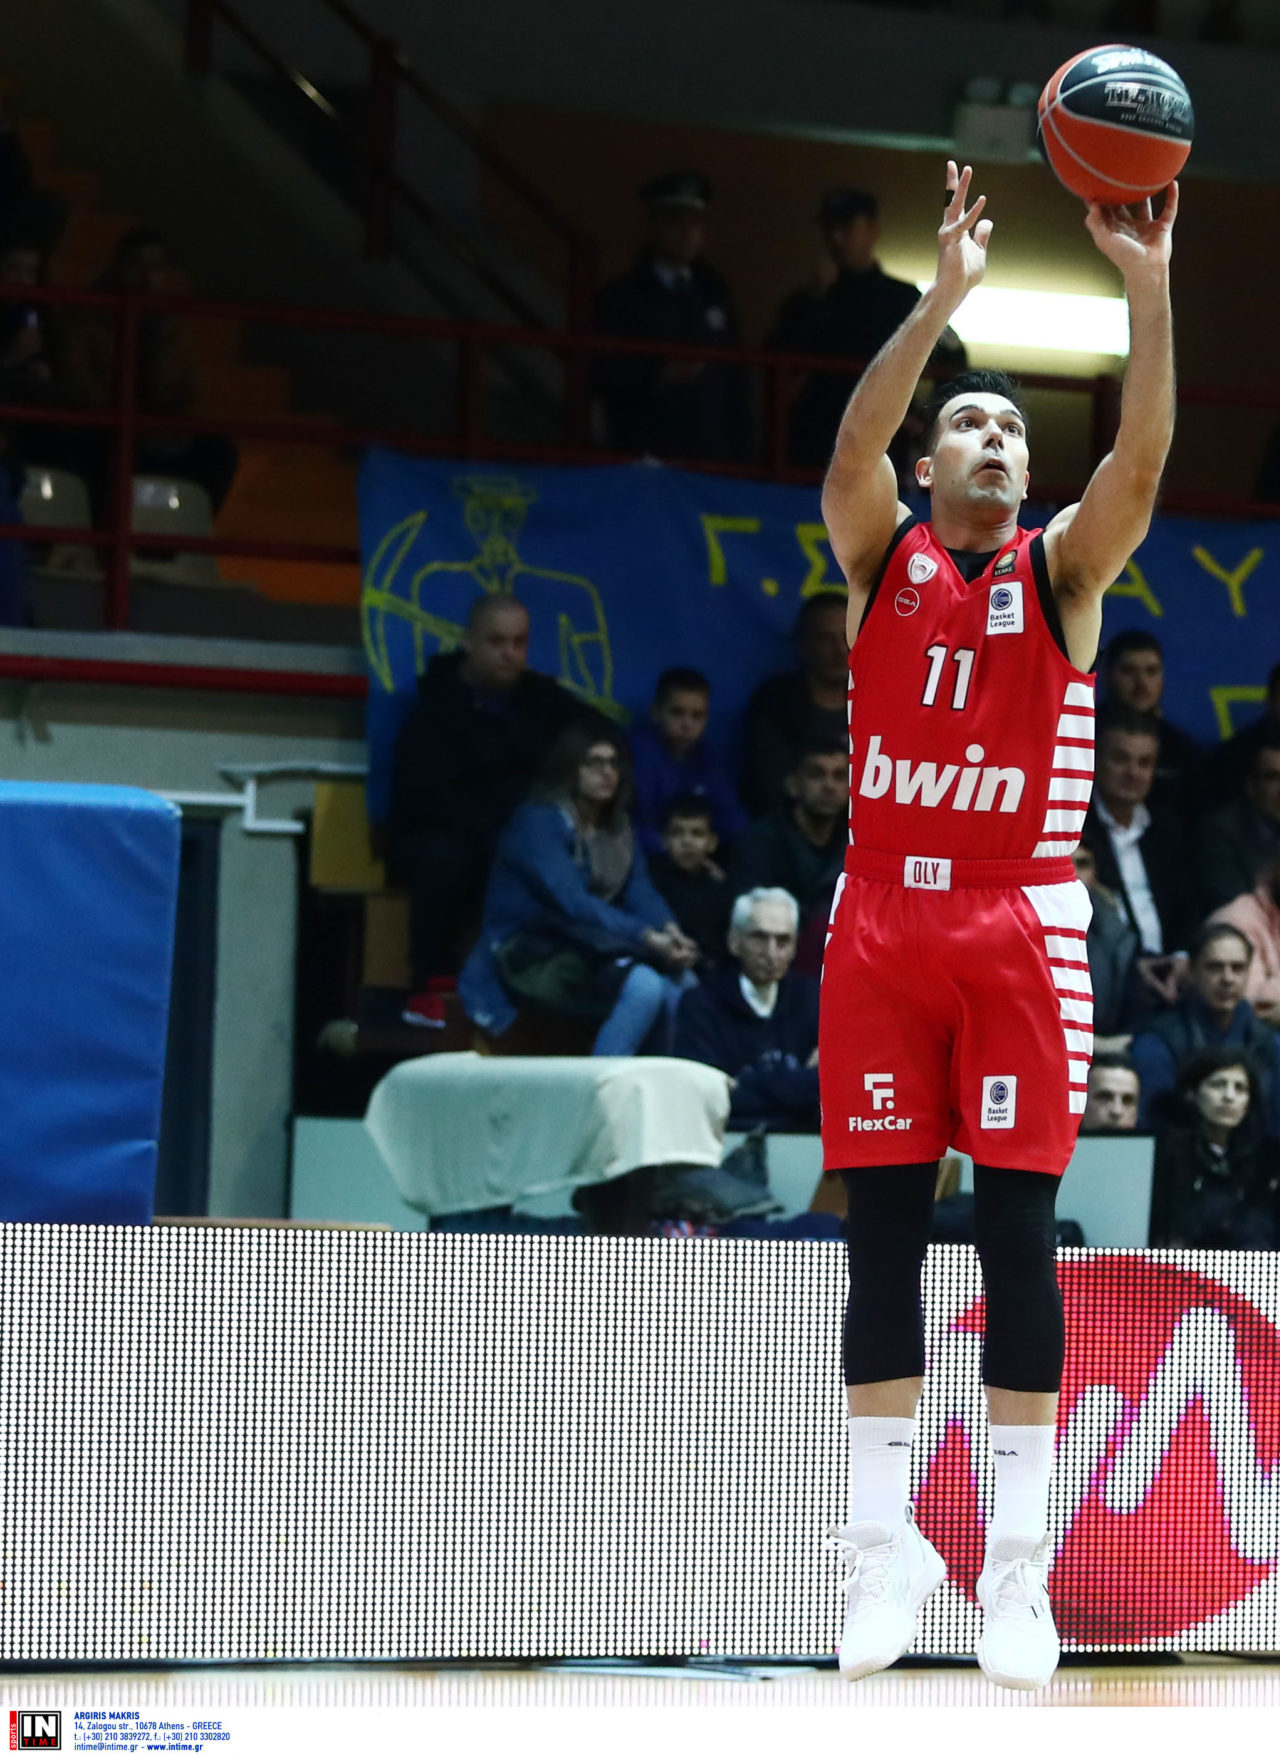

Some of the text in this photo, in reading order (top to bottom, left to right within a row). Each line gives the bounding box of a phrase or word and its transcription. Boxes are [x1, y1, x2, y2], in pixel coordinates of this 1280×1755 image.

[990, 612, 1015, 621] Basket
[990, 620, 1015, 628] League
[921, 643, 975, 711] 11
[859, 734, 1026, 813] bwin
[913, 860, 940, 885] OLY
[987, 1106, 1008, 1115] Basket
[848, 1115, 913, 1132] FlexCar
[987, 1114, 1008, 1123] League
